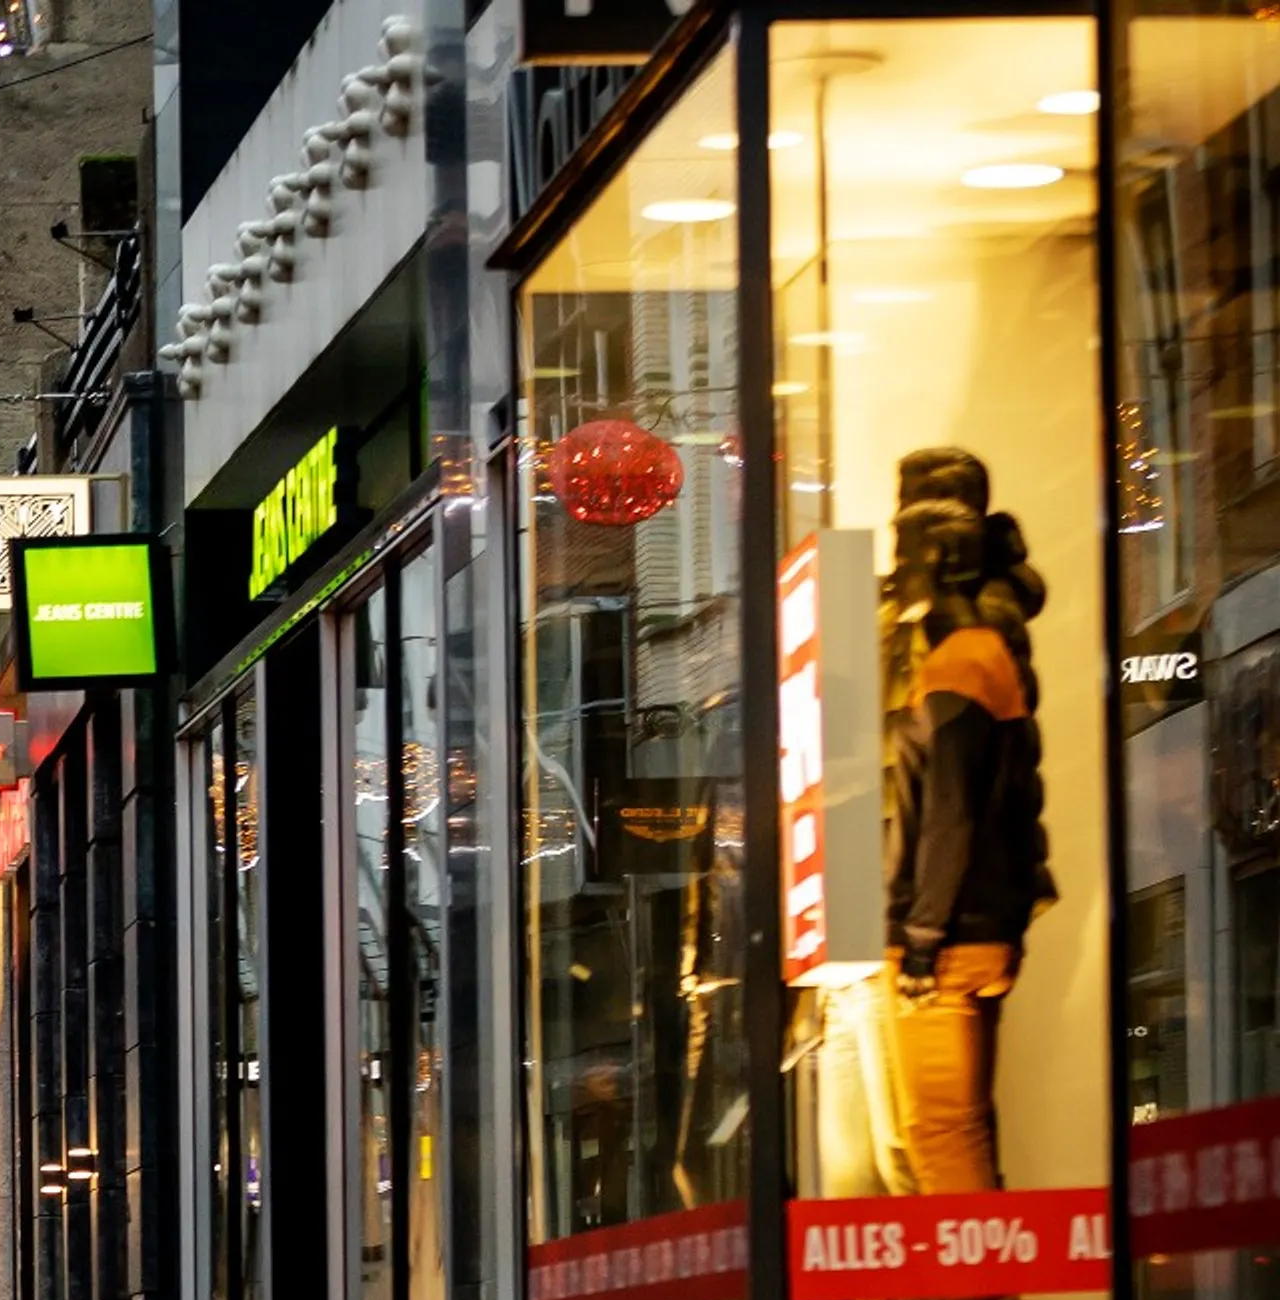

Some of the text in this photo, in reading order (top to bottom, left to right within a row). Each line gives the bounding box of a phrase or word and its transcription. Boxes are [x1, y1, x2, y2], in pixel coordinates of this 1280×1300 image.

[33, 601, 145, 622] JEANS CENTRE
[802, 1221, 908, 1273] ALLES
[935, 1216, 1039, 1266] 50%
